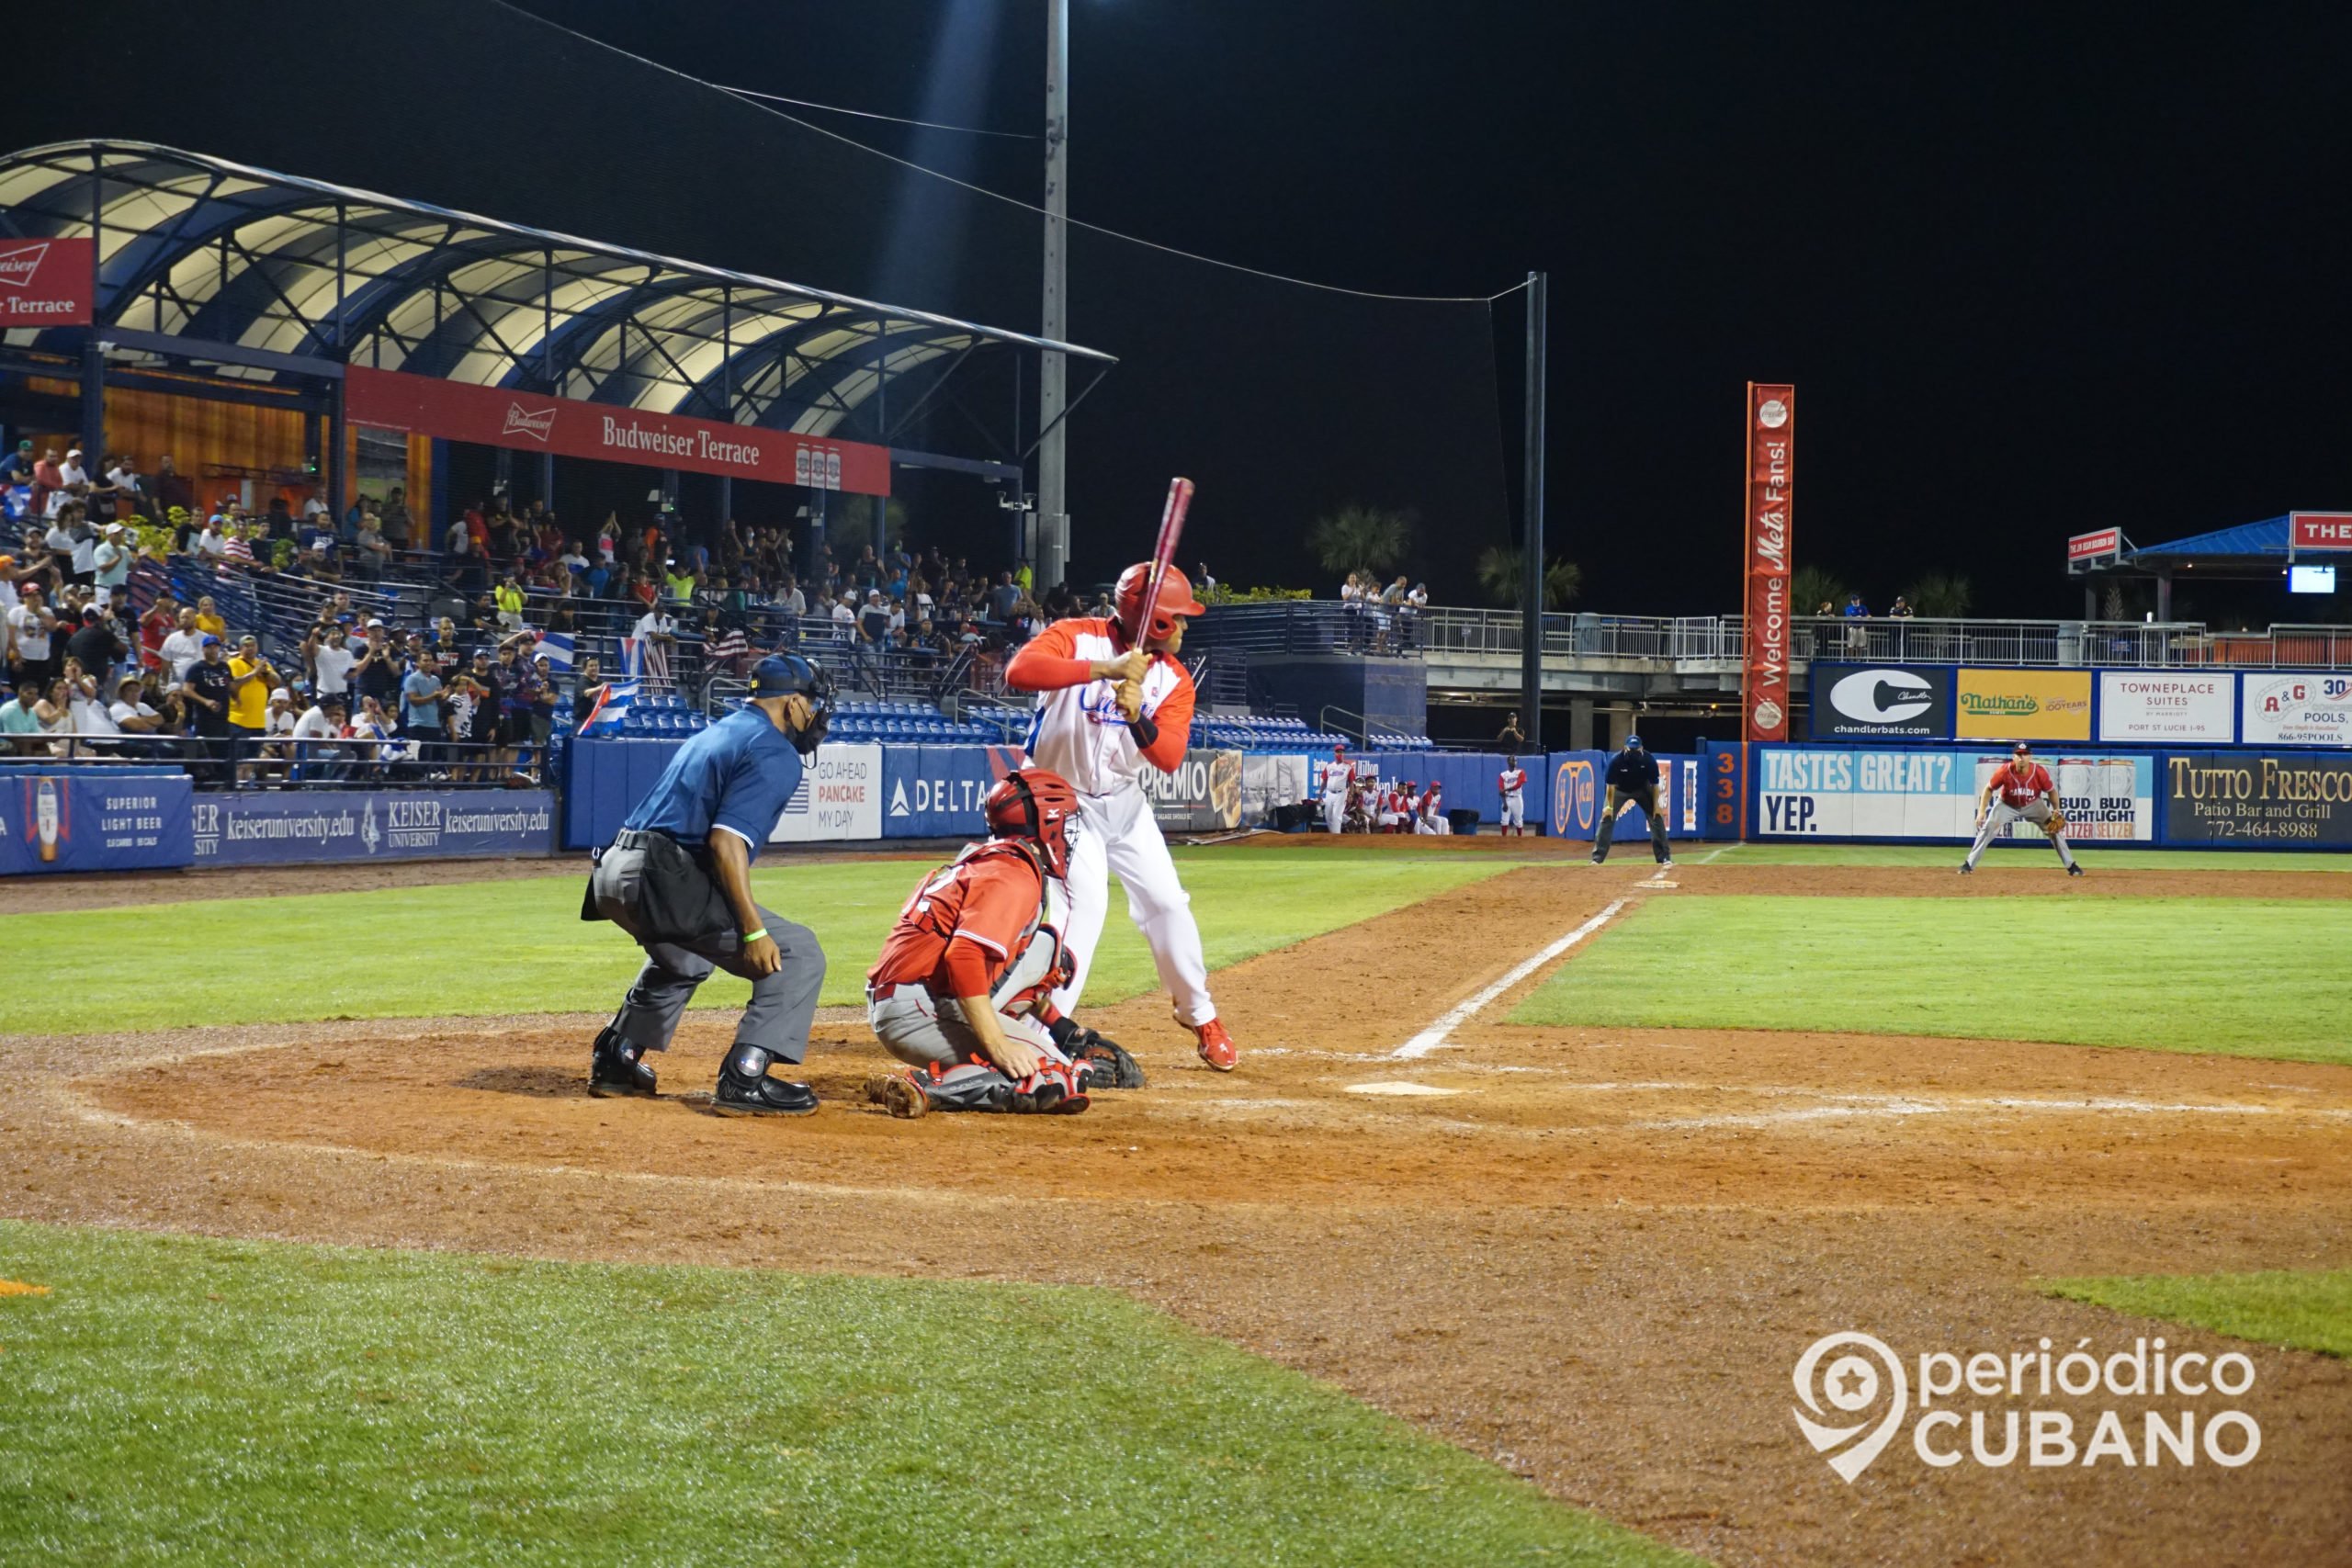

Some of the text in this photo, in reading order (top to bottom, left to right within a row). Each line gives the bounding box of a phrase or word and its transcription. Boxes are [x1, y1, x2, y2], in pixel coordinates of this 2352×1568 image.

[7, 296, 74, 313] Terrace
[603, 416, 760, 466] Budweiser Terrace
[2304, 524, 2352, 538] THE
[1757, 442, 1785, 687] Welcome Mets Fans!
[2120, 683, 2215, 694] TOWNEPLACE
[2324, 679, 2346, 695] 30
[1961, 693, 2039, 712] Nathan's
[2146, 696, 2188, 706] SUITES
[2265, 685, 2305, 712] A & G
[1834, 725, 1930, 735] chandlerbats.com
[2278, 732, 2343, 742] 866-95POOLS
[819, 761, 867, 780] GO AHEAD
[1357, 760, 1378, 776] Hilton
[1766, 752, 1951, 792] TASTES GREAT?
[1141, 761, 1207, 800] PREMIO
[819, 785, 865, 803] PANCAKE
[916, 779, 986, 812] DELTA
[107, 796, 157, 810] SUPERIOR
[2059, 797, 2091, 809] BUD
[2099, 797, 2131, 809] BUD
[2194, 802, 2331, 818] Patio Bar and Grill
[389, 801, 441, 827] KEISER
[819, 809, 854, 828] MY DAY
[1766, 795, 1816, 831] YEP.
[2063, 811, 2094, 822] IGHT
[2096, 811, 2135, 822] LIGHT
[102, 817, 162, 830] LIGHT BEER
[227, 809, 355, 845] keiseruniversity.edu
[445, 807, 548, 839] keiseruniversity.edu
[2098, 823, 2133, 838] SELTZER
[2207, 820, 2317, 838] 772-464-8988
[389, 832, 440, 847] UNIVERSITY
